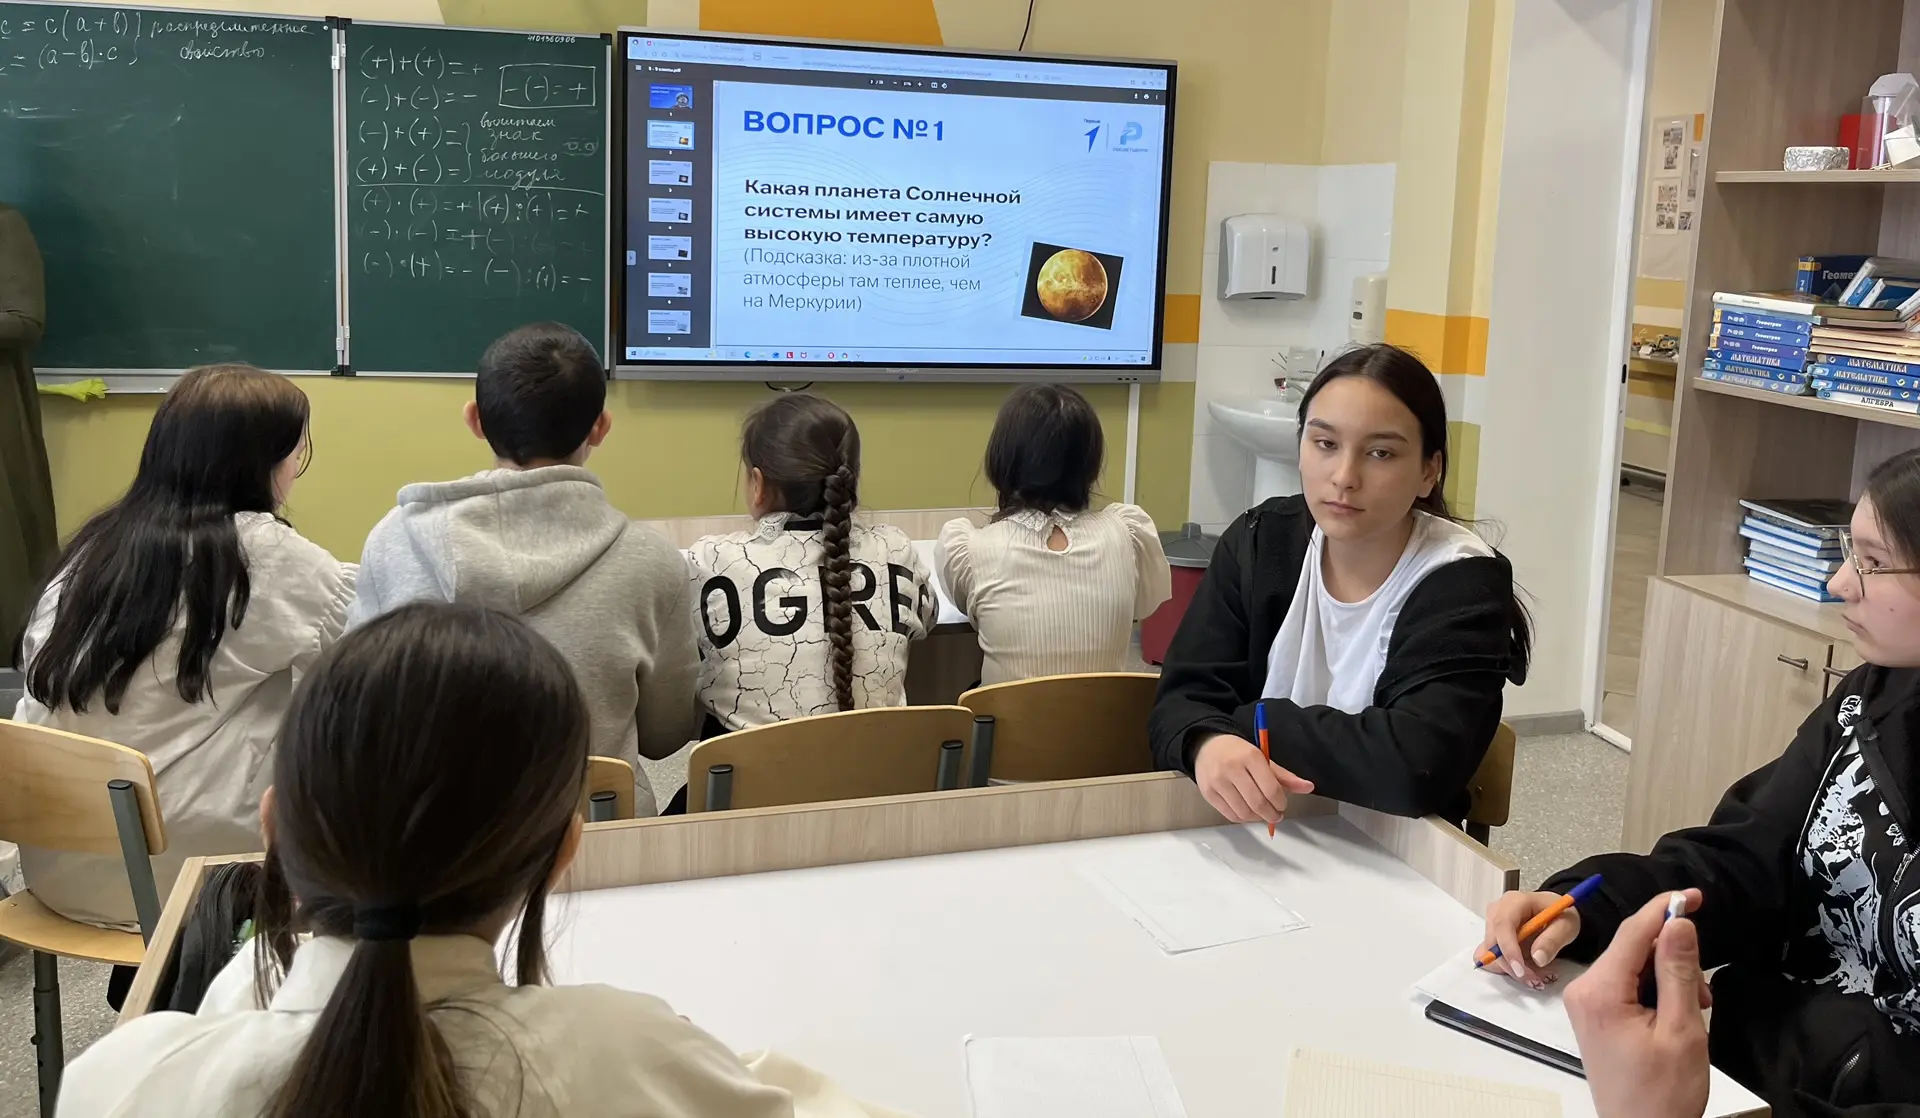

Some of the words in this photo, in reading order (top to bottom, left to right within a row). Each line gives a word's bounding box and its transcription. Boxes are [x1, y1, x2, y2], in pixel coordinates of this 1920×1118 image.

[744, 110, 884, 138] ВОПРОС
[488, 128, 543, 150] знак
[745, 179, 809, 196] Какая
[815, 184, 901, 200] планета
[906, 186, 1021, 204] Солнечной
[744, 204, 841, 220] системы
[846, 210, 911, 223] имеет
[916, 212, 984, 227] самую
[744, 228, 842, 246] высокую
[847, 233, 993, 249] температуру?
[744, 248, 847, 266] (Подсказка:
[852, 254, 897, 268] из-за
[902, 255, 971, 269] плотной
[743, 272, 845, 288] атмосферы
[849, 276, 879, 288] там
[884, 277, 945, 291] теплее,
[950, 279, 981, 291] чем
[1822, 271, 1857, 280] Геоме
[743, 295, 763, 308] на
[768, 294, 862, 312] Меркурии)
[1756, 320, 1782, 328] Геометрия
[1752, 345, 1778, 353] Геометрия
[1730, 353, 1780, 367] МАТЕМАТИКА
[1847, 358, 1907, 373] МАТЕМАТИКА
[1725, 364, 1770, 378] МАТЕМАТИКА
[1833, 370, 1888, 384] МАТЕМАТИКА
[1721, 373, 1764, 388] МАТЕМАТИКА
[1837, 383, 1892, 396] МАТЕМАТИКА
[1860, 396, 1894, 408] АЛГЕБРА
